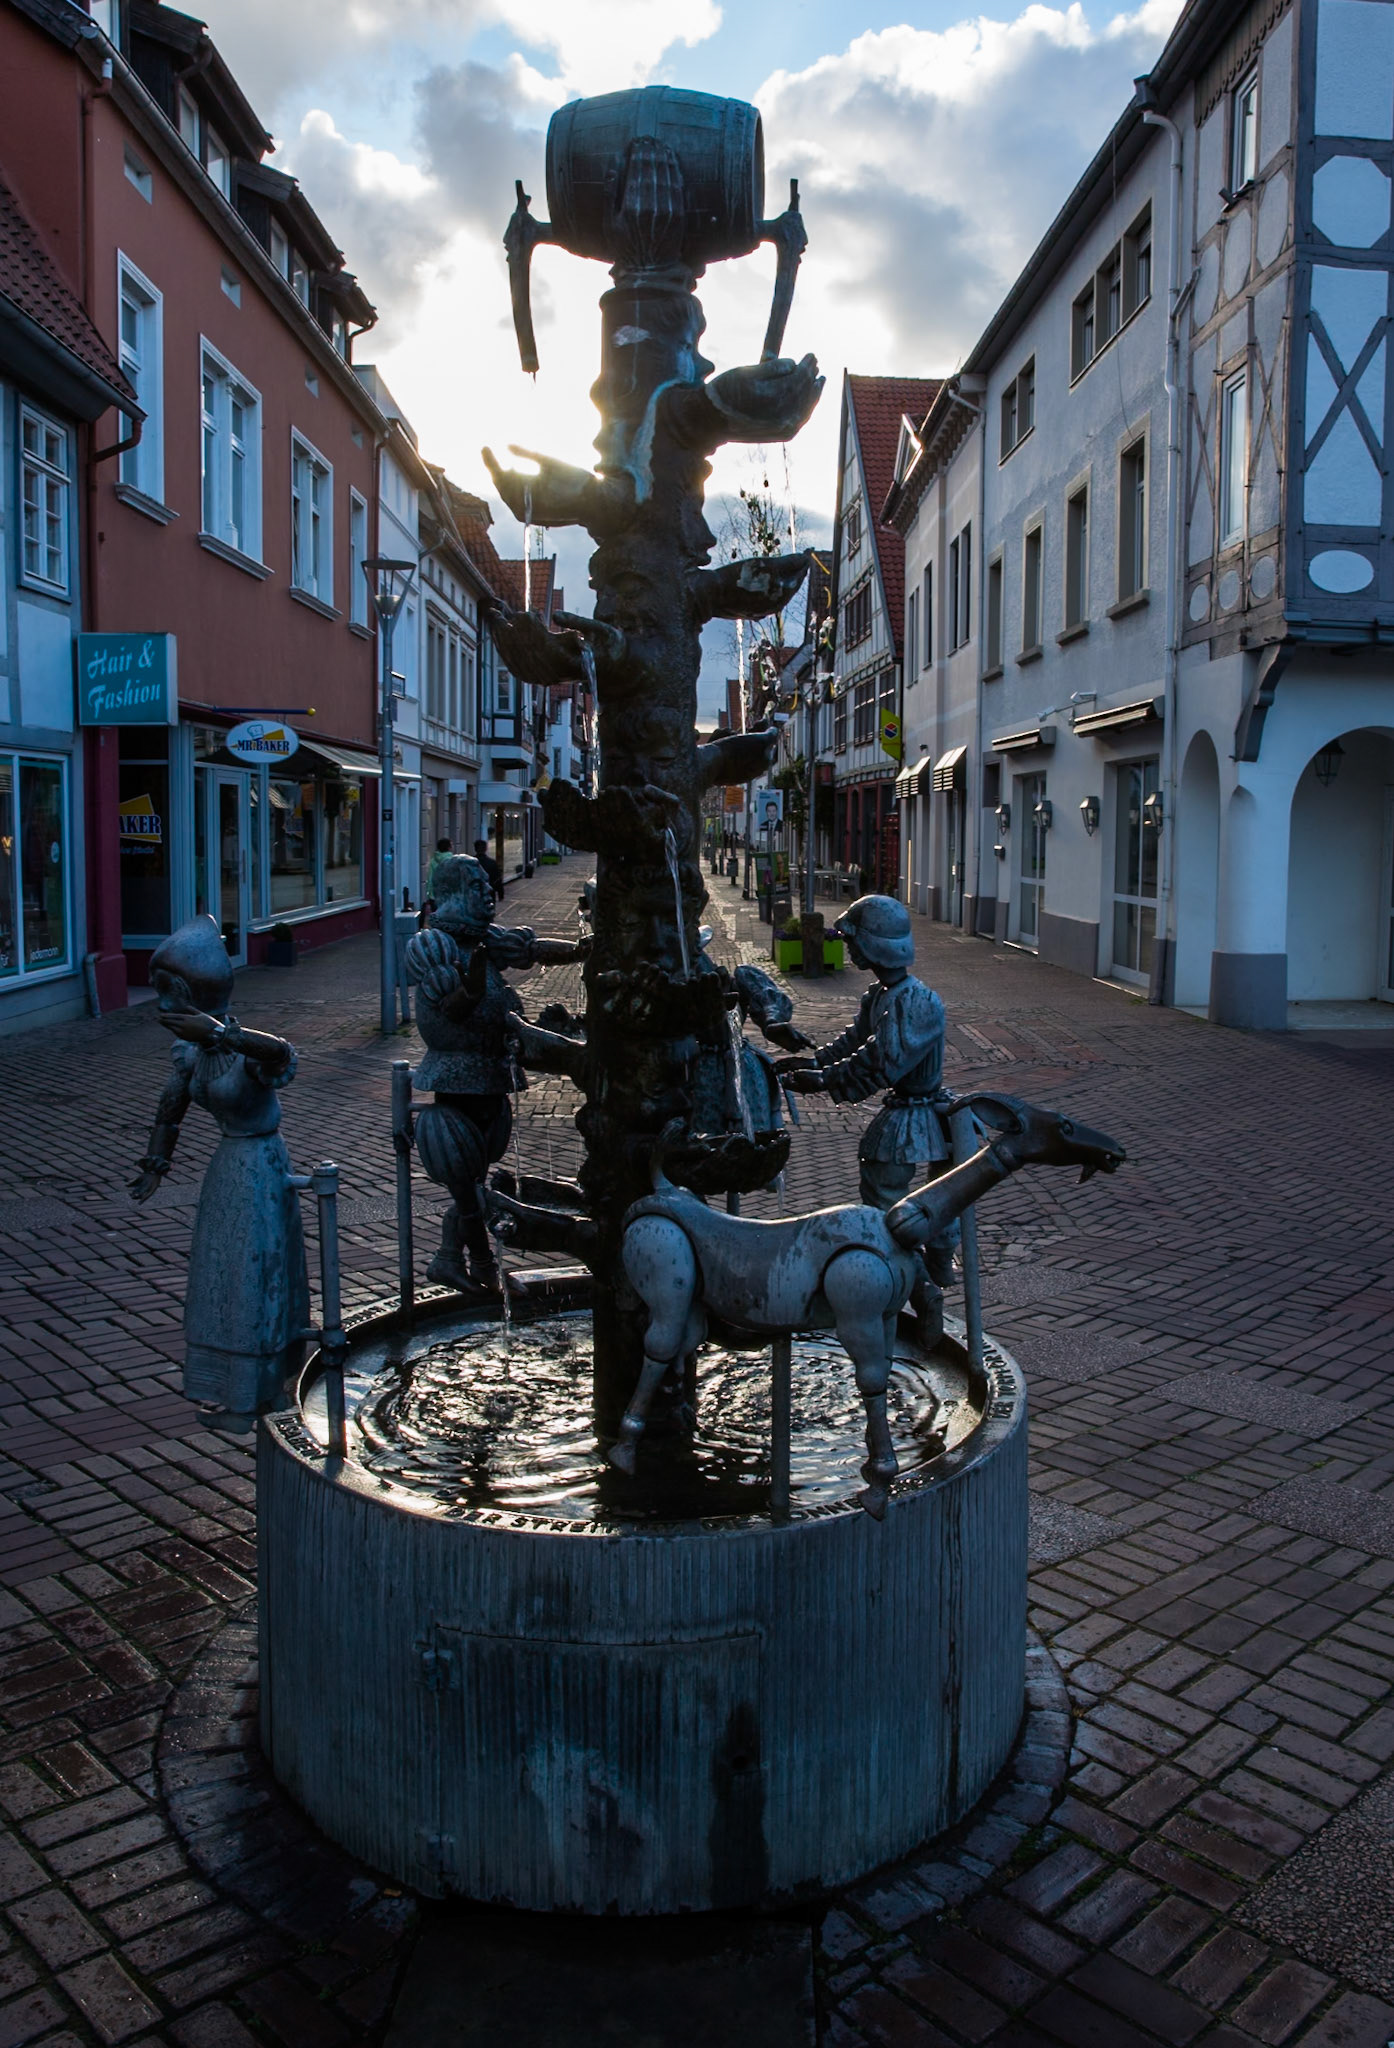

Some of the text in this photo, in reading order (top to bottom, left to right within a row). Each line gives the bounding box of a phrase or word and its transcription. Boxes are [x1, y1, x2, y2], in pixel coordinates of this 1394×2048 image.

[87, 639, 156, 680] Hair &
[88, 678, 161, 719] Fashion
[256, 739, 290, 751] BAKER
[119, 815, 161, 834] AKER
[444, 1506, 503, 1526] DER
